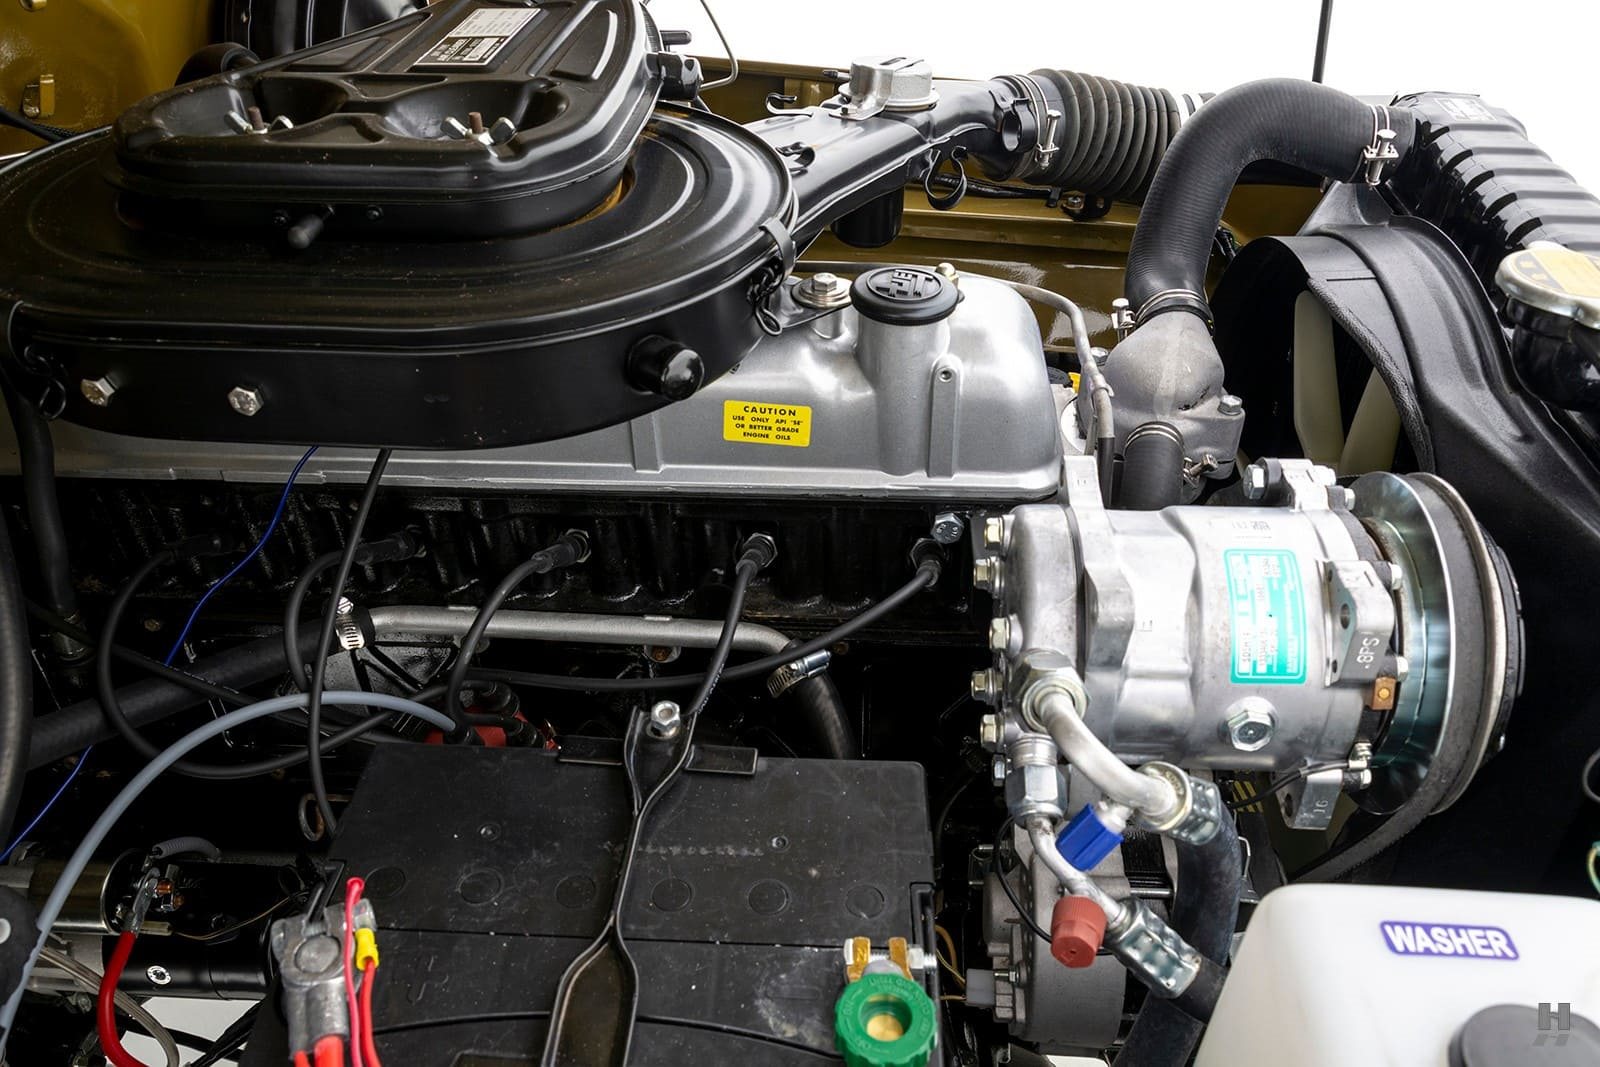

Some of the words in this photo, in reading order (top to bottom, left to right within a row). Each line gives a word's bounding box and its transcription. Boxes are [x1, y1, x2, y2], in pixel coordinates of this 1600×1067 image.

[743, 405, 796, 416] CAUTION
[743, 431, 769, 439] ENGINE
[1383, 924, 1517, 958] WASHER
